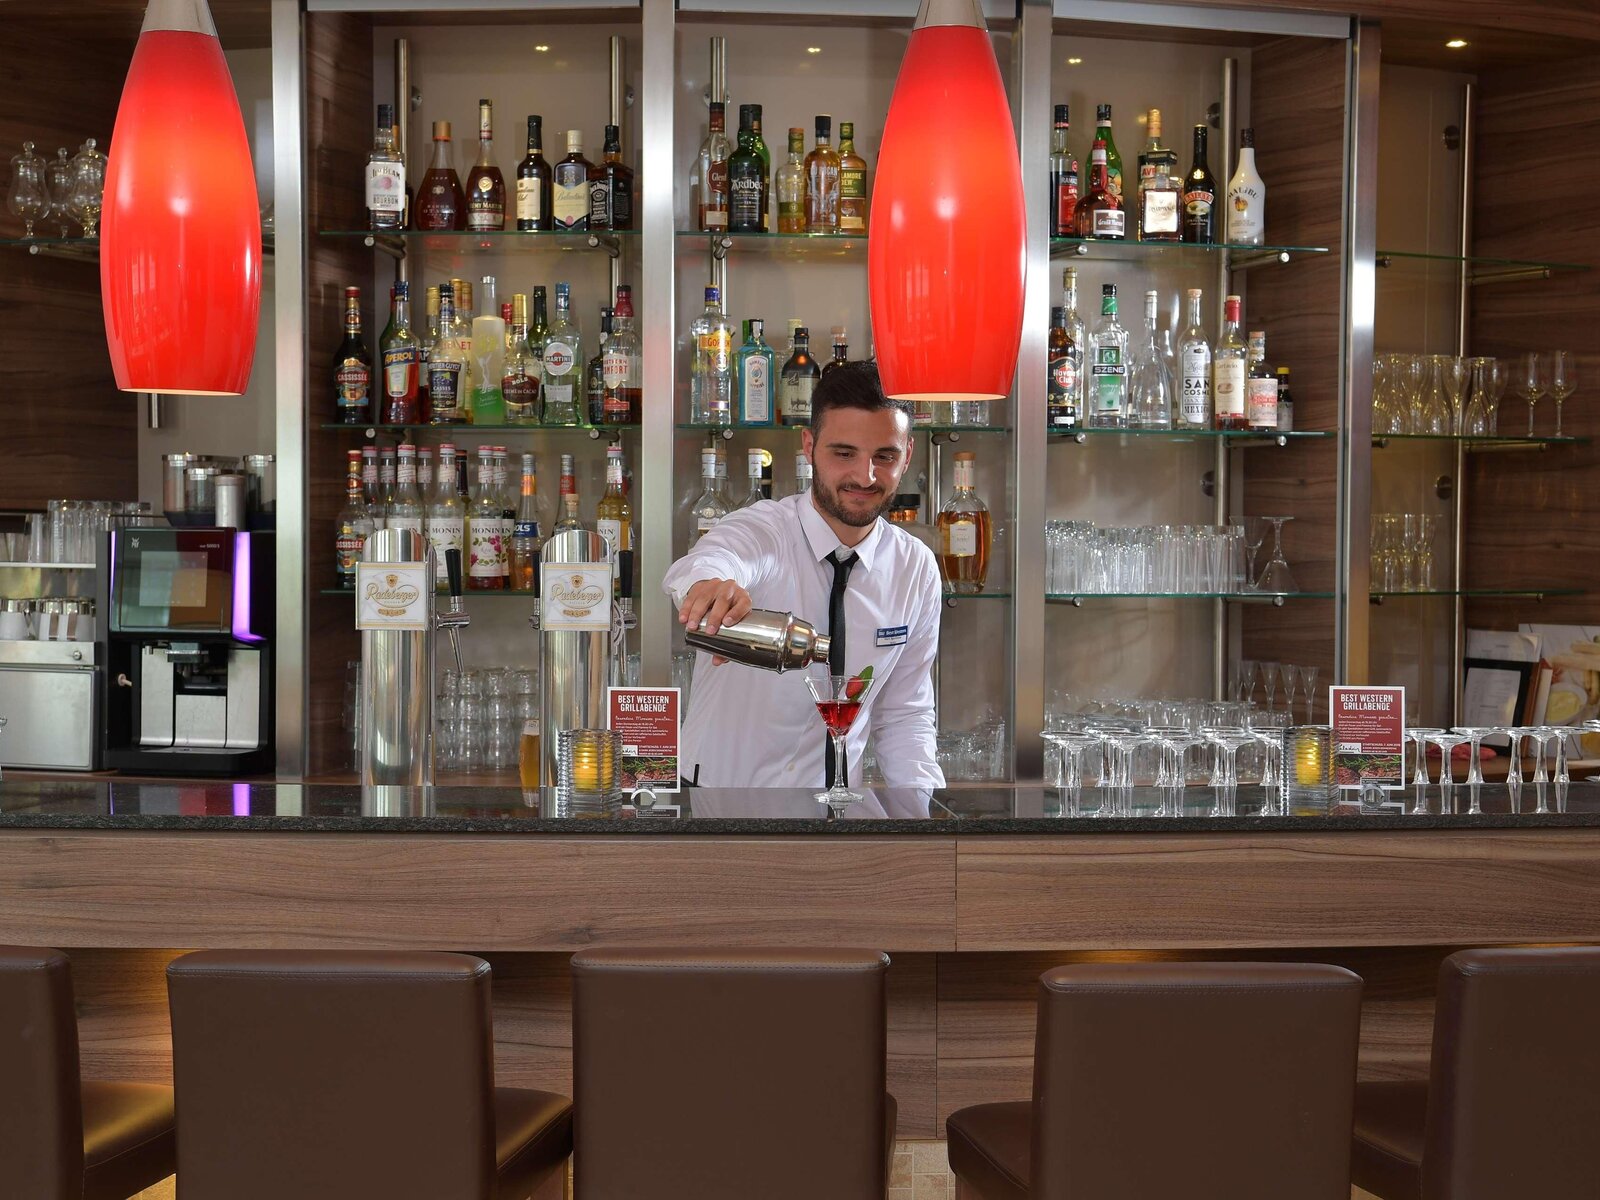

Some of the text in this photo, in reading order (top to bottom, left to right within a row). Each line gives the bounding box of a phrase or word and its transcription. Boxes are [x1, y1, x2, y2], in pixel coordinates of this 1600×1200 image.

[841, 172, 862, 180] LAMORE
[373, 196, 399, 205] BOURBON
[385, 351, 413, 365] APEROL
[1094, 366, 1124, 374] SZENE
[1185, 379, 1210, 389] SAN
[1185, 406, 1209, 414] MEXIC
[514, 524, 531, 532] OLS
[365, 582, 417, 603] Radeberger
[552, 583, 601, 604] Radeberger
[618, 695, 669, 704] BEST WESTERN
[1340, 694, 1393, 703] BEST WESTERN
[620, 703, 667, 712] GRILLABENDE
[1343, 702, 1391, 711] GRILLABENDE
